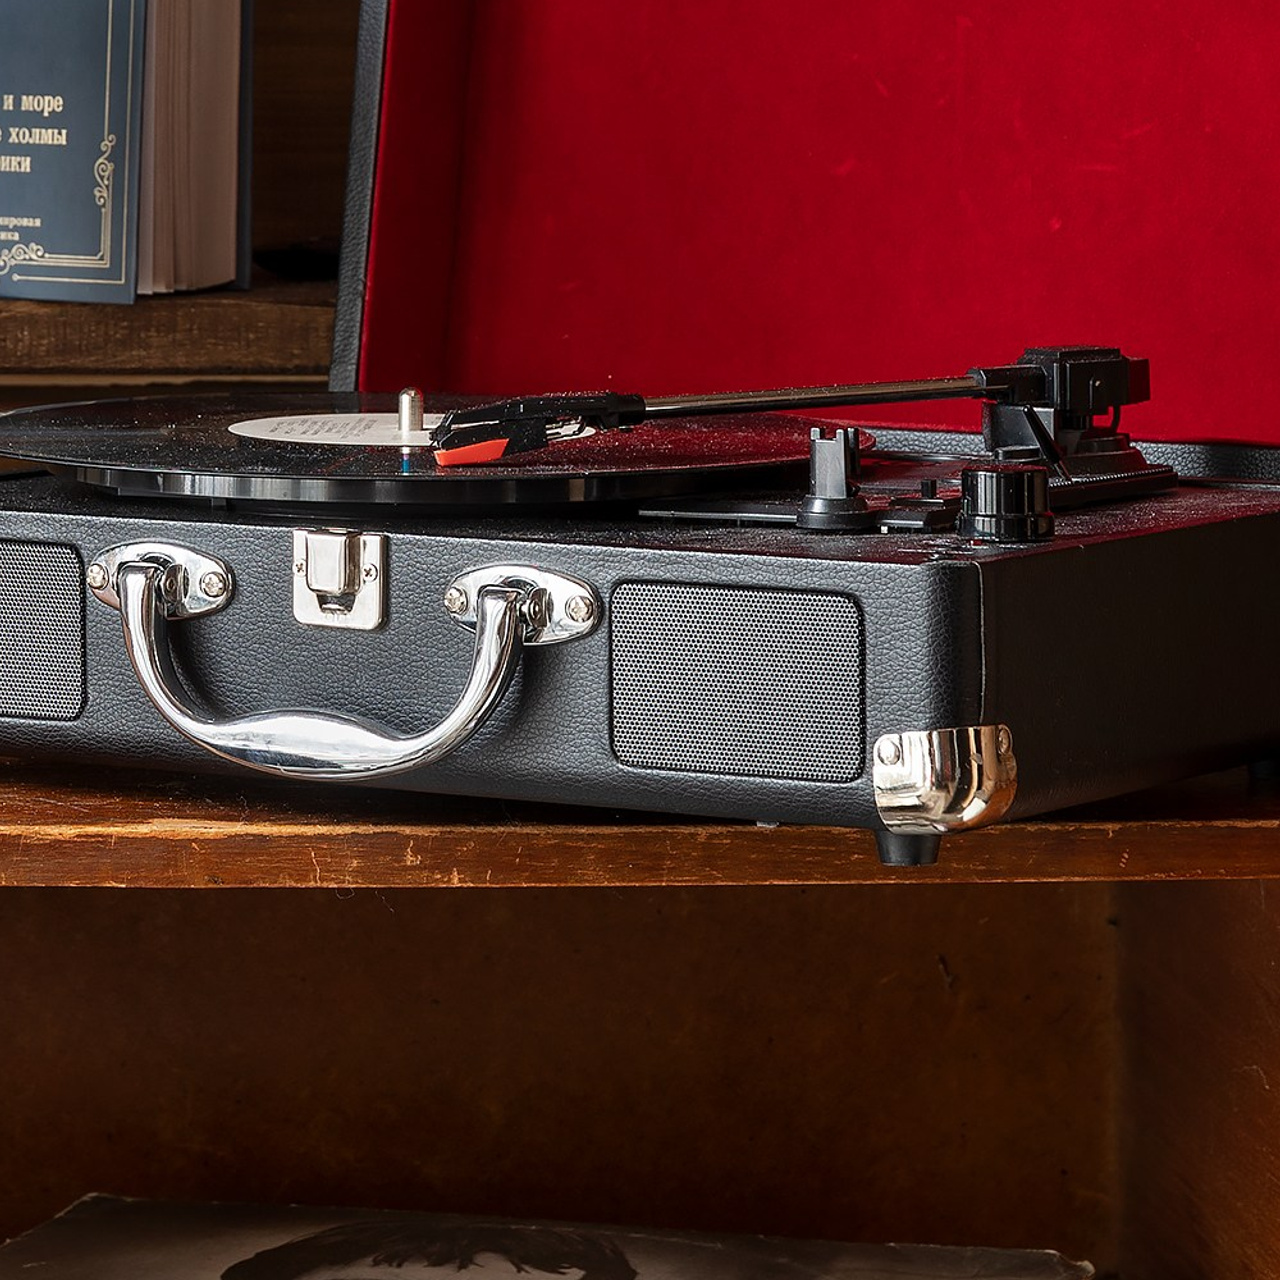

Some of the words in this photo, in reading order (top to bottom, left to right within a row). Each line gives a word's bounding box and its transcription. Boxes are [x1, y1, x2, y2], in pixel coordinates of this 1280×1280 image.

[3, 94, 14, 111] и
[21, 94, 64, 117] море
[8, 127, 68, 146] холмы
